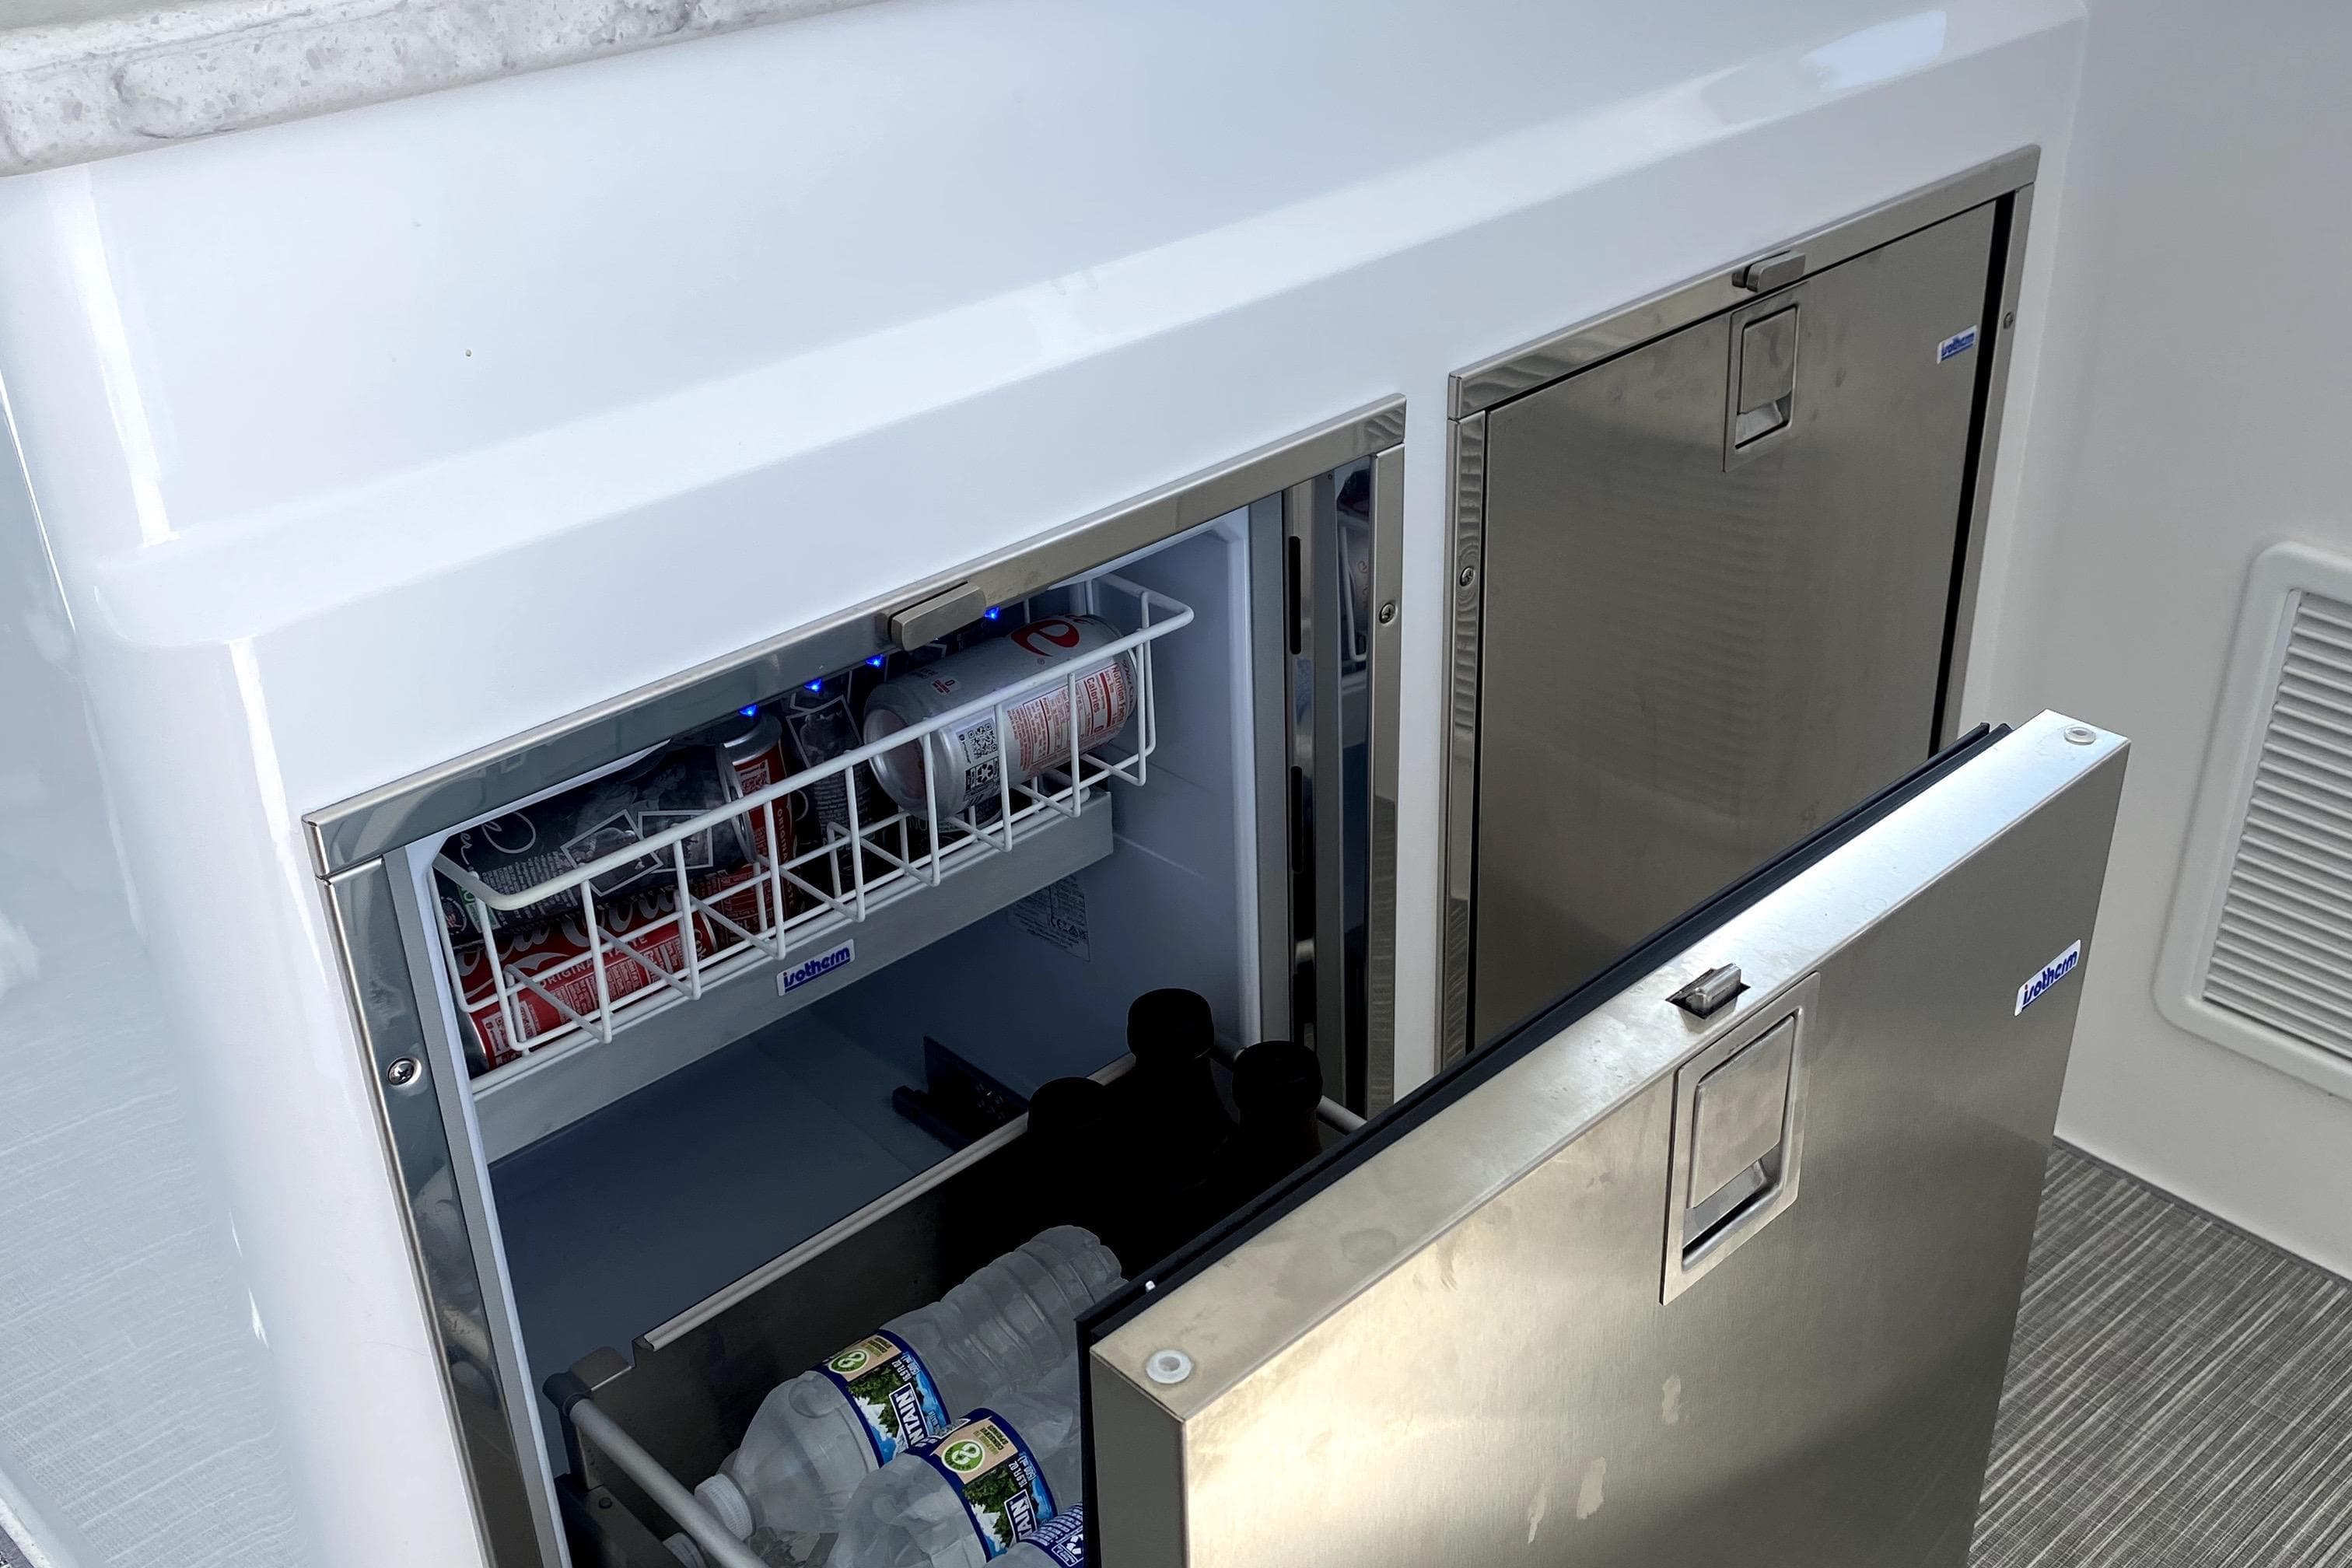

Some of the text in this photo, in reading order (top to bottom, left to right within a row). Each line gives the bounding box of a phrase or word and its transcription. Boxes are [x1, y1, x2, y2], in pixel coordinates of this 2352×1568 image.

[1087, 677, 1100, 713] Calories
[1112, 666, 1124, 702] Nutrition
[776, 807, 789, 864] ORIGINA
[539, 957, 594, 989] ORIGINA
[607, 935, 648, 958] TATE
[783, 947, 850, 988] isotherm
[2023, 951, 2077, 1005] isotherm
[895, 1388, 924, 1447] NTAIN
